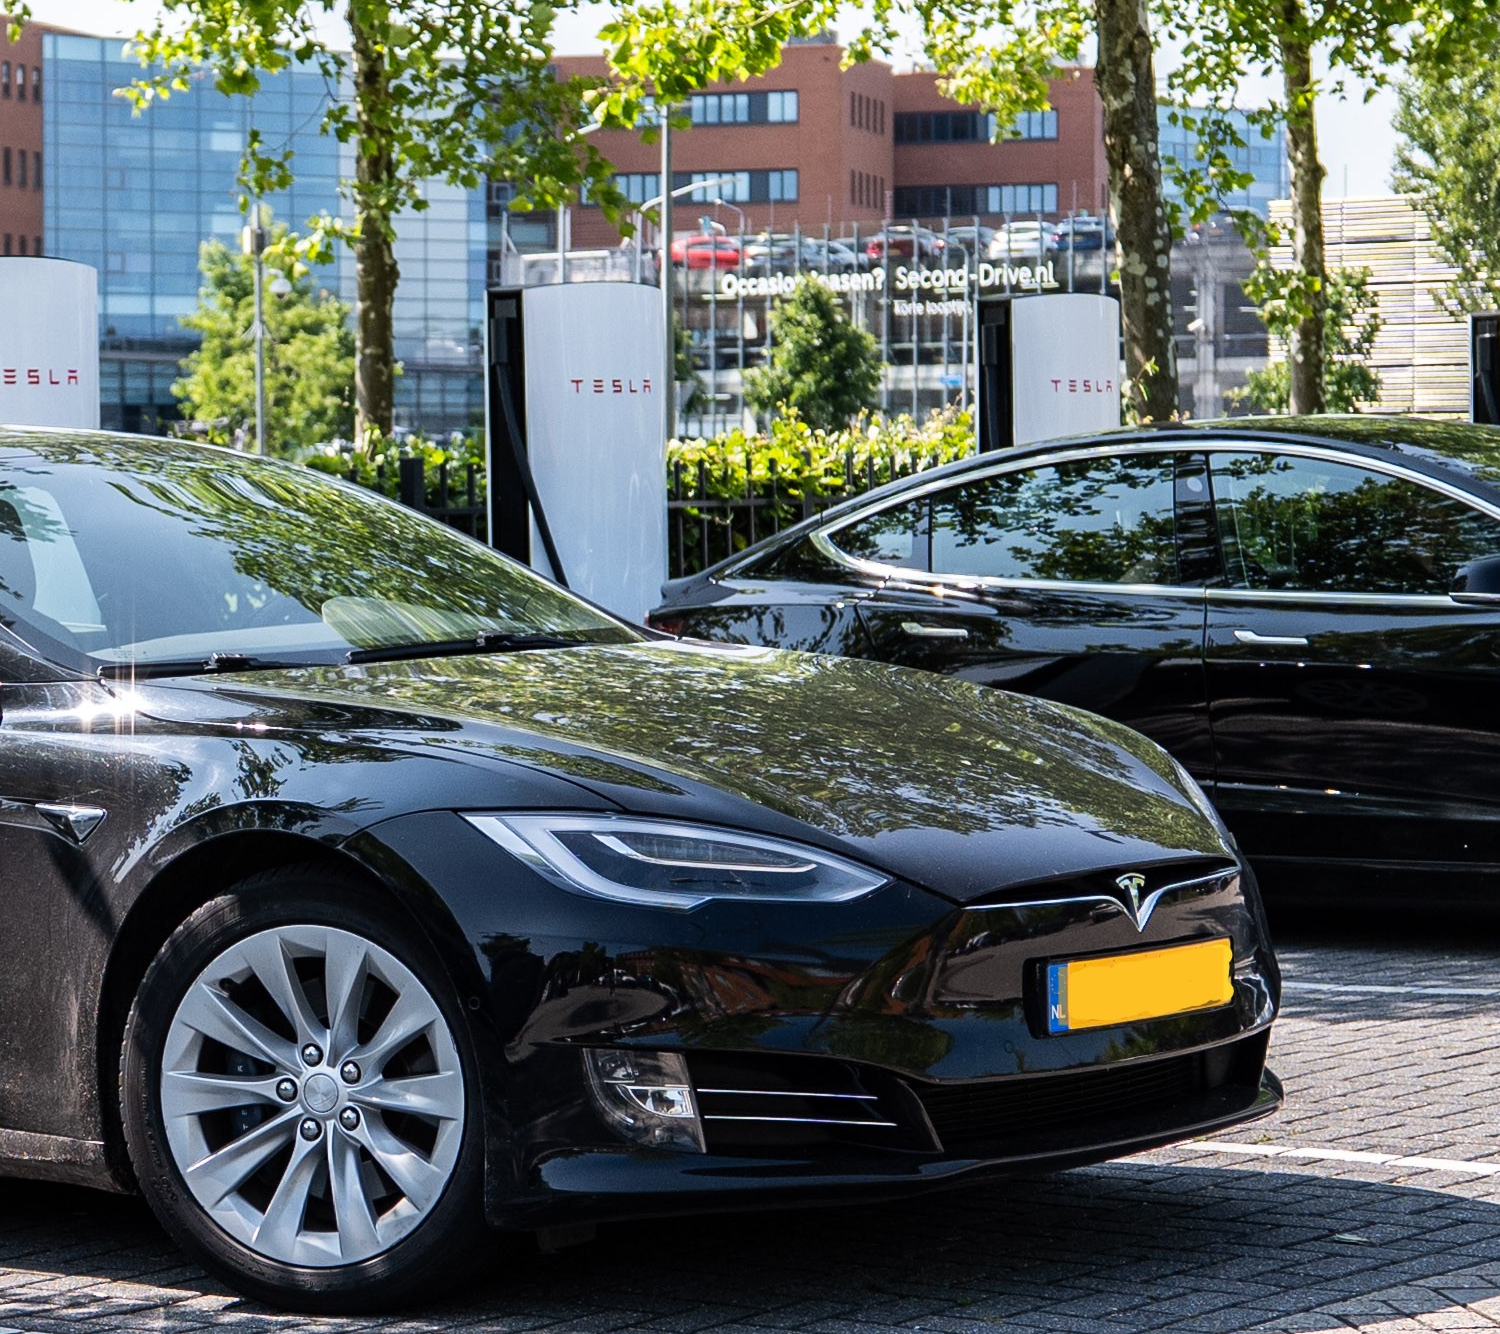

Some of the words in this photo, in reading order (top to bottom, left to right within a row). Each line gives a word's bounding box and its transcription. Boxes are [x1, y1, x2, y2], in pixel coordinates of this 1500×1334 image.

[811, 267, 886, 293] easen?
[896, 261, 1056, 290] Second-Drive.nl
[570, 379, 651, 393] TESLA
[1051, 379, 1113, 393] TESLA
[1051, 1004, 1066, 1020] NL
